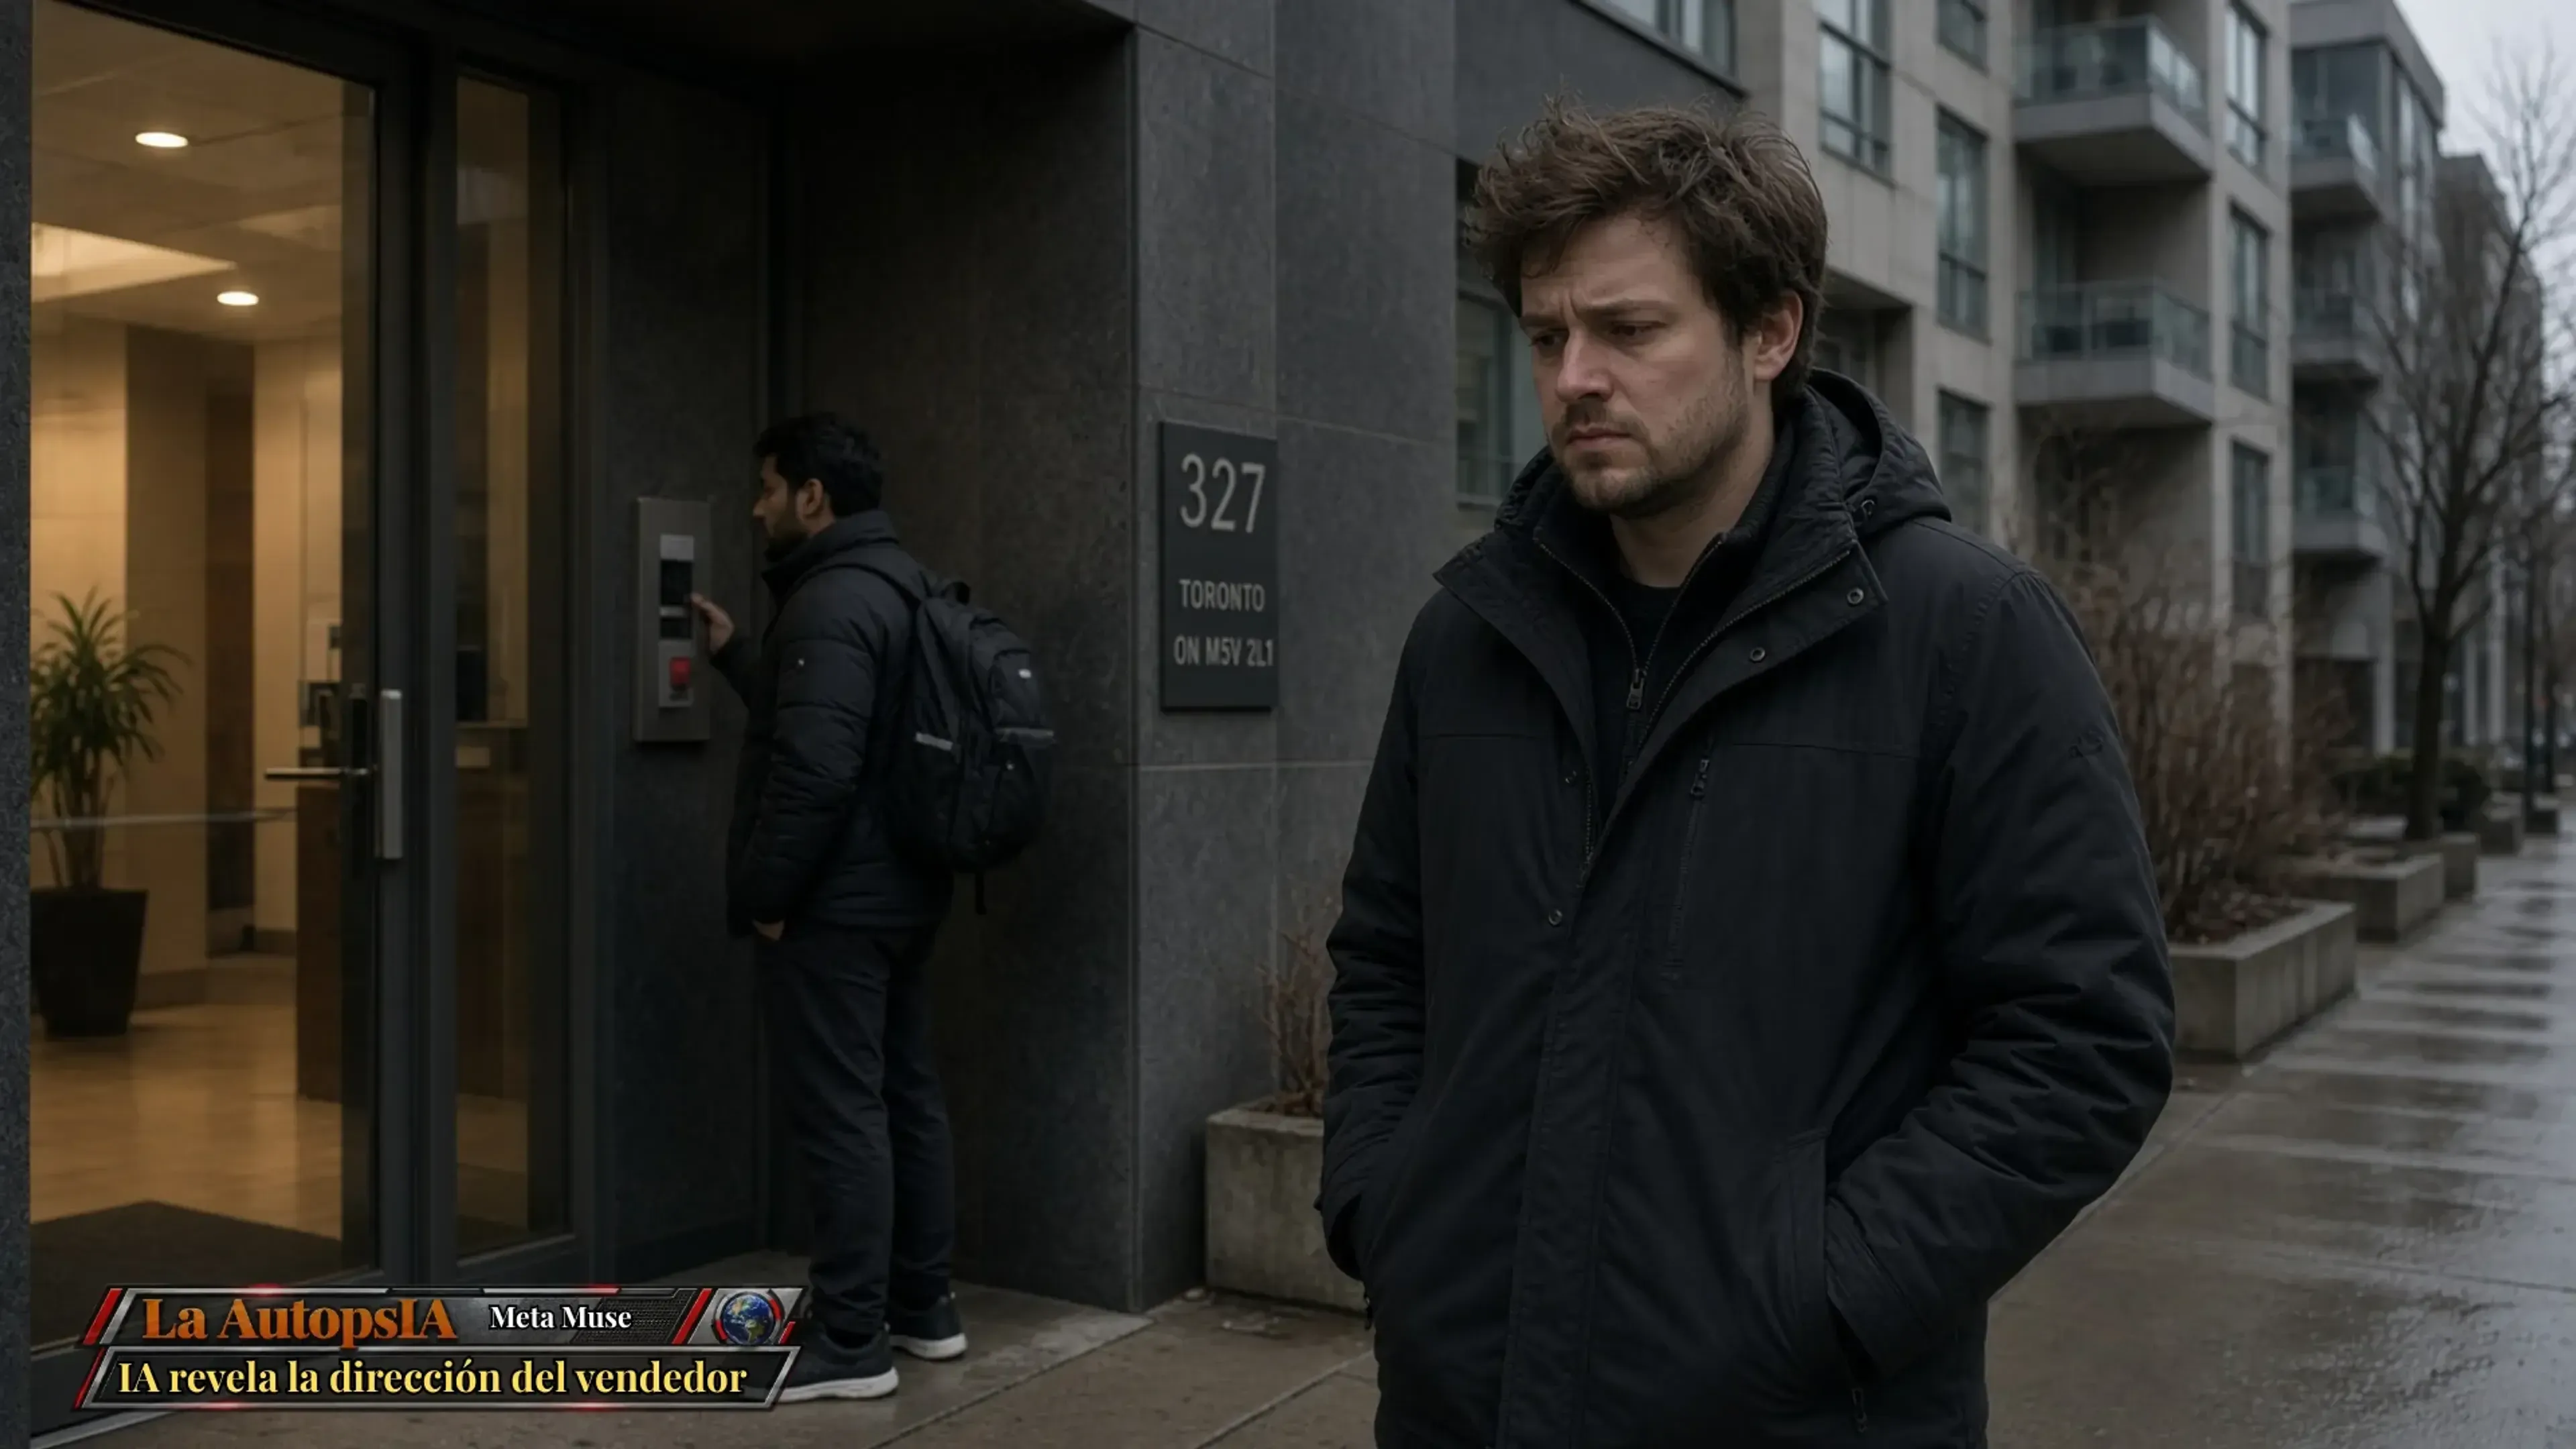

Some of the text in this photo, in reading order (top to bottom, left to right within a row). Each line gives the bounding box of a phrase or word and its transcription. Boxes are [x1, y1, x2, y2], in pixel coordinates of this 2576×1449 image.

[1180, 453, 1266, 533] 327
[1179, 578, 1265, 612] TORONTO
[1173, 635, 1273, 667] ON M5V 2L1
